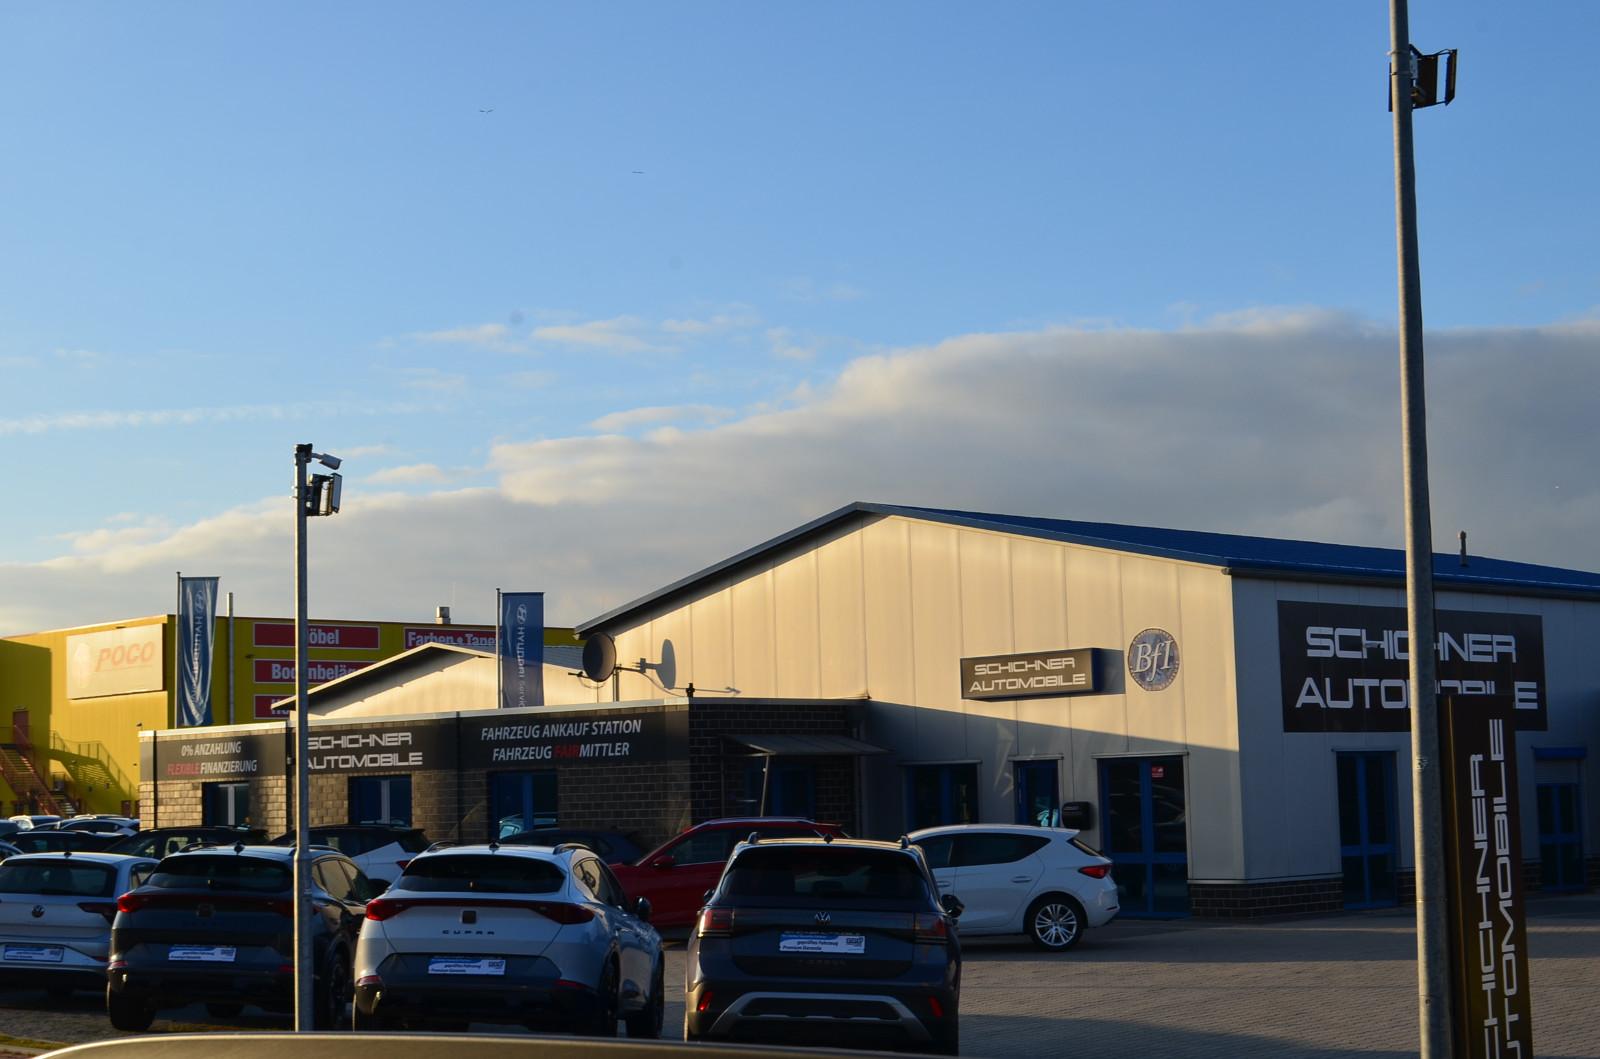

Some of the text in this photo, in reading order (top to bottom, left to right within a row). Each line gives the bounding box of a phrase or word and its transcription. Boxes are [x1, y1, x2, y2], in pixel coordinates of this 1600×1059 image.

[307, 629, 340, 645] öbel
[95, 641, 156, 672] POCO
[516, 626, 525, 677] HYUNDAI
[974, 657, 1075, 676] SCHICHNER
[969, 673, 1086, 692] AUTOMOBILE
[481, 719, 642, 741] FAHRZEUG ANKAUF STATION
[181, 741, 242, 756] 0% ANZAHLUNG
[492, 745, 552, 761] FAHRZEUG
